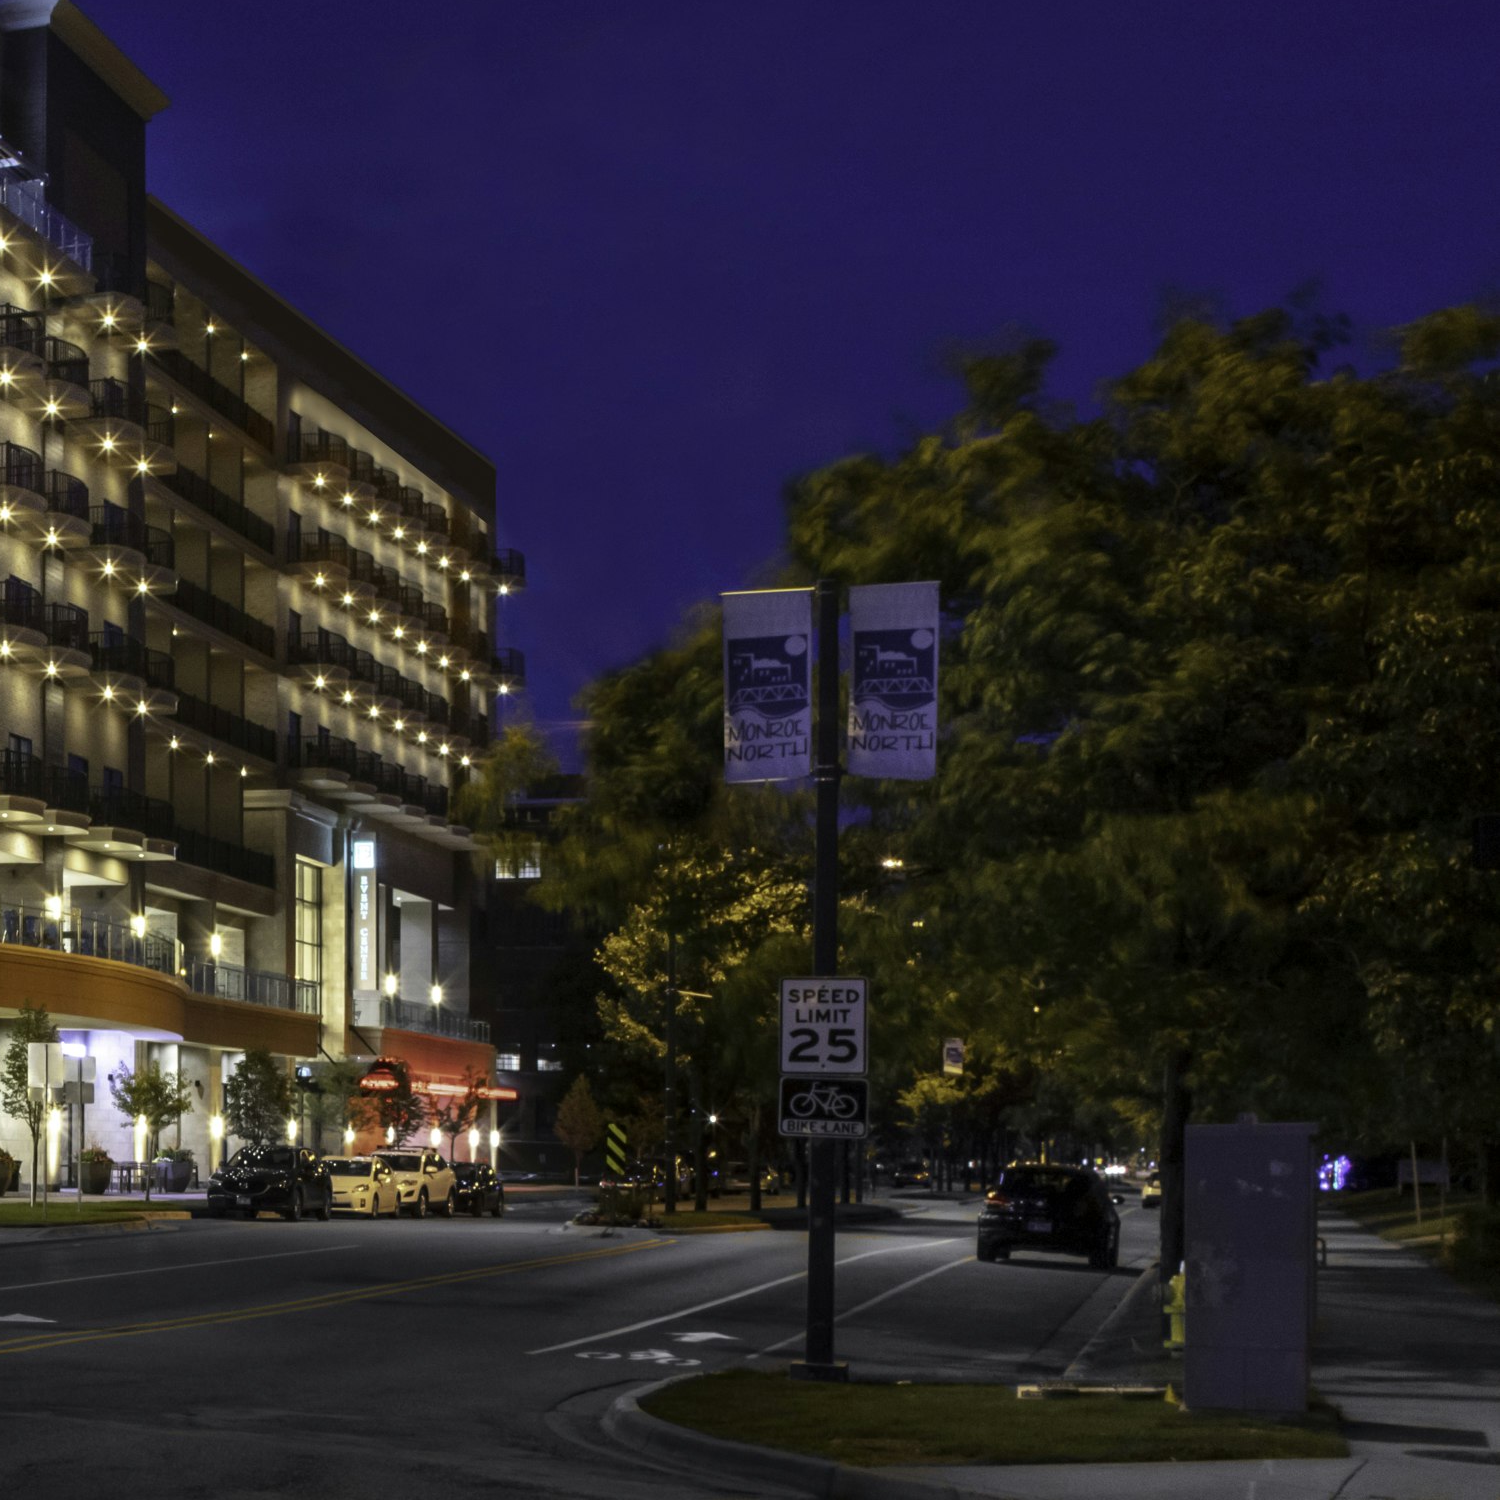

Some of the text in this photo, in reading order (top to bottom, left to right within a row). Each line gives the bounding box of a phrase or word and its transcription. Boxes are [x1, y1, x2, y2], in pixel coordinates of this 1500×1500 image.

[728, 718, 807, 742] MONROE
[853, 709, 933, 731] MONROE
[727, 737, 808, 762] NORTH
[851, 731, 934, 751] NORTH
[788, 989, 860, 1004] SPEED
[796, 1009, 851, 1024] LIMIT
[788, 1028, 858, 1064] 25
[787, 1120, 859, 1134] BIKE LANE
